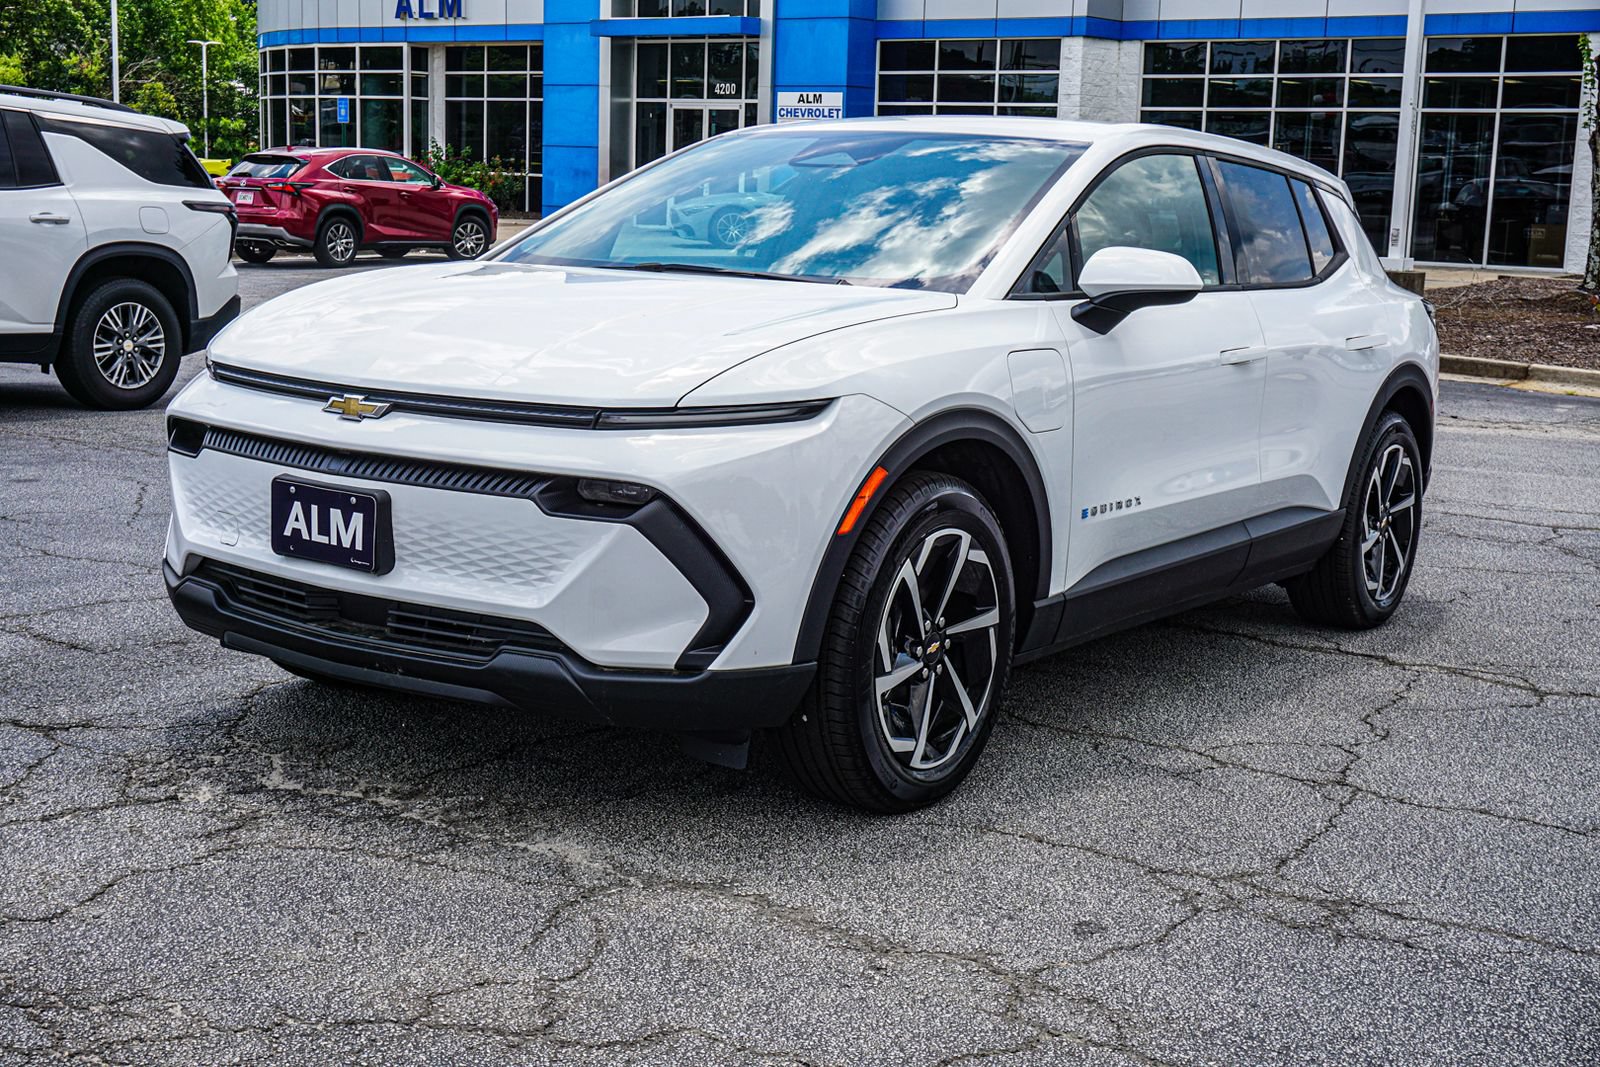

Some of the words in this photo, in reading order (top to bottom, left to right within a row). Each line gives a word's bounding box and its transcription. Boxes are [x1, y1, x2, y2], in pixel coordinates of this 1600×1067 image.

[395, 0, 462, 19] ALM
[714, 83, 736, 95] 4200
[797, 93, 822, 104] ALM
[778, 107, 841, 118] CHEVROLET
[1081, 496, 1141, 519] EQUINOX
[283, 500, 364, 551] ALM
